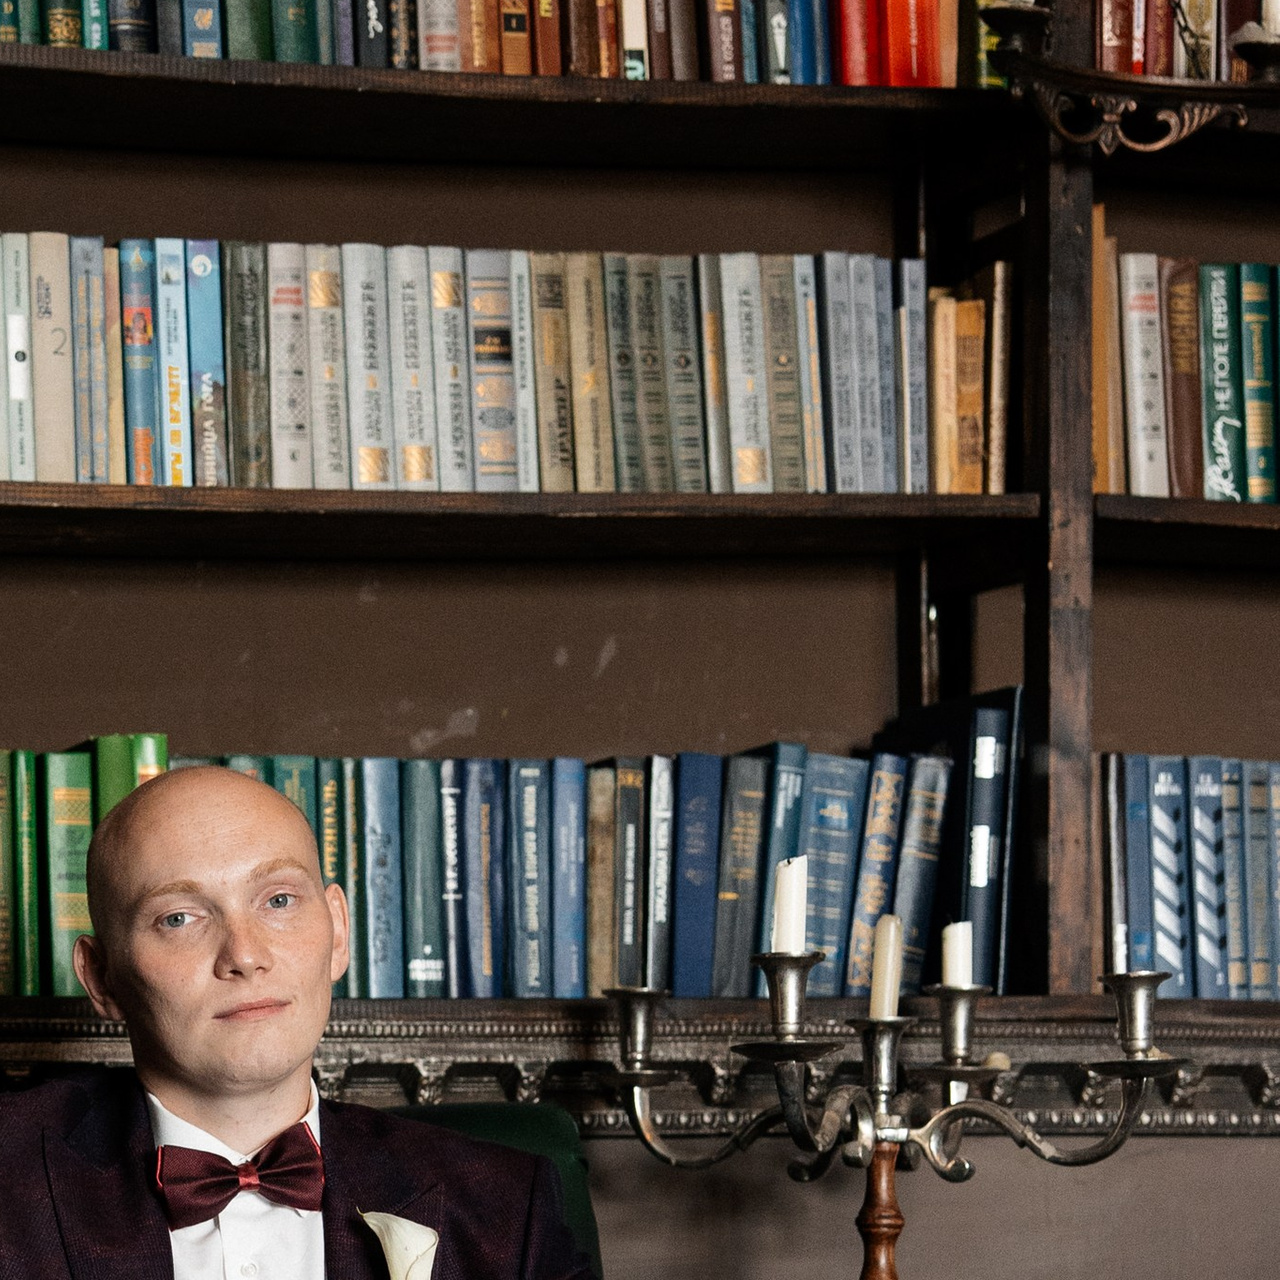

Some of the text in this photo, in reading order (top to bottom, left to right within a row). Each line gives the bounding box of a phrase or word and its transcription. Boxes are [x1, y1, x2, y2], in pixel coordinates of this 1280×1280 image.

[51, 326, 68, 357] 2
[1214, 388, 1231, 412] НЕ
[322, 779, 338, 879] СТЕНДАЛЬ
